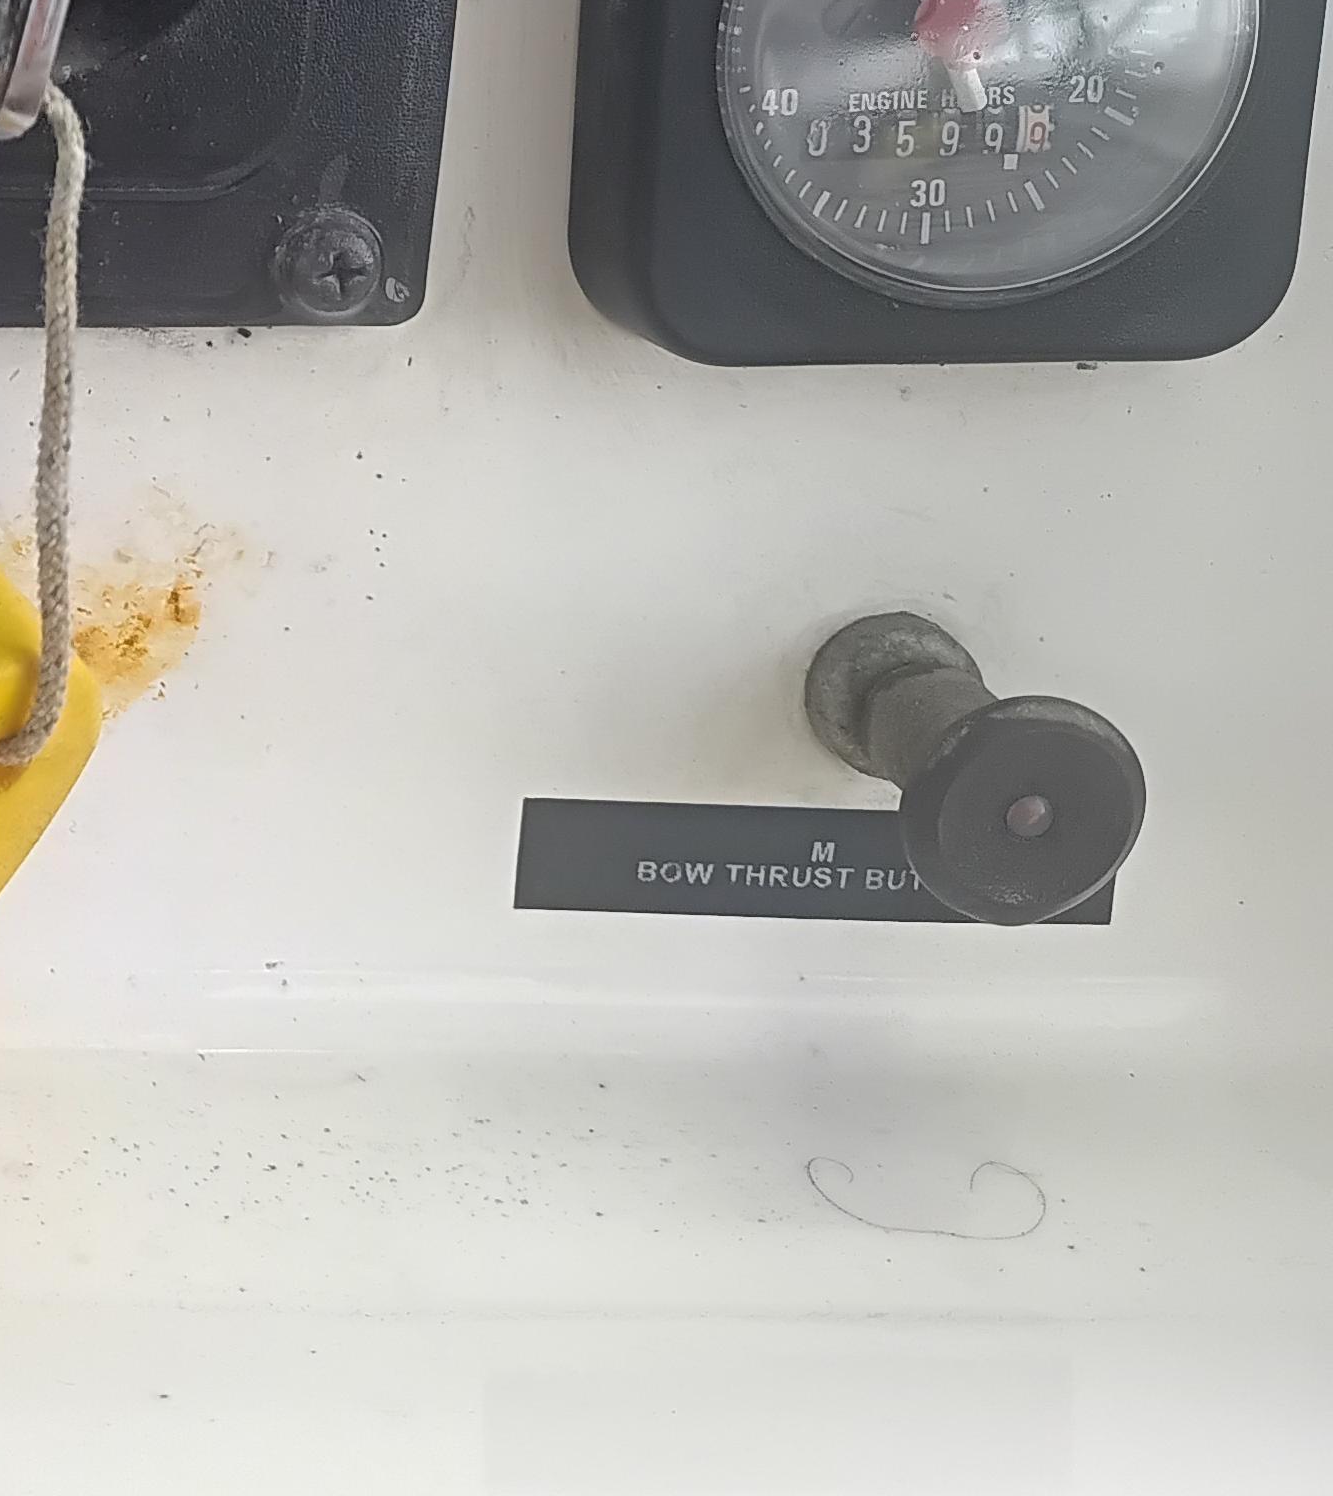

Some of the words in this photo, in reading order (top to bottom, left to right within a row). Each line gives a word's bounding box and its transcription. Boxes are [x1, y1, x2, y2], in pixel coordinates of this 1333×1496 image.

[761, 87, 800, 117] 40
[848, 89, 928, 113] ENGINE
[941, 85, 1016, 108] HRS
[1068, 75, 1105, 105] 20
[910, 178, 946, 208] 30
[810, 841, 835, 863] M
[636, 860, 714, 885] BOW
[725, 863, 856, 889] THRUST
